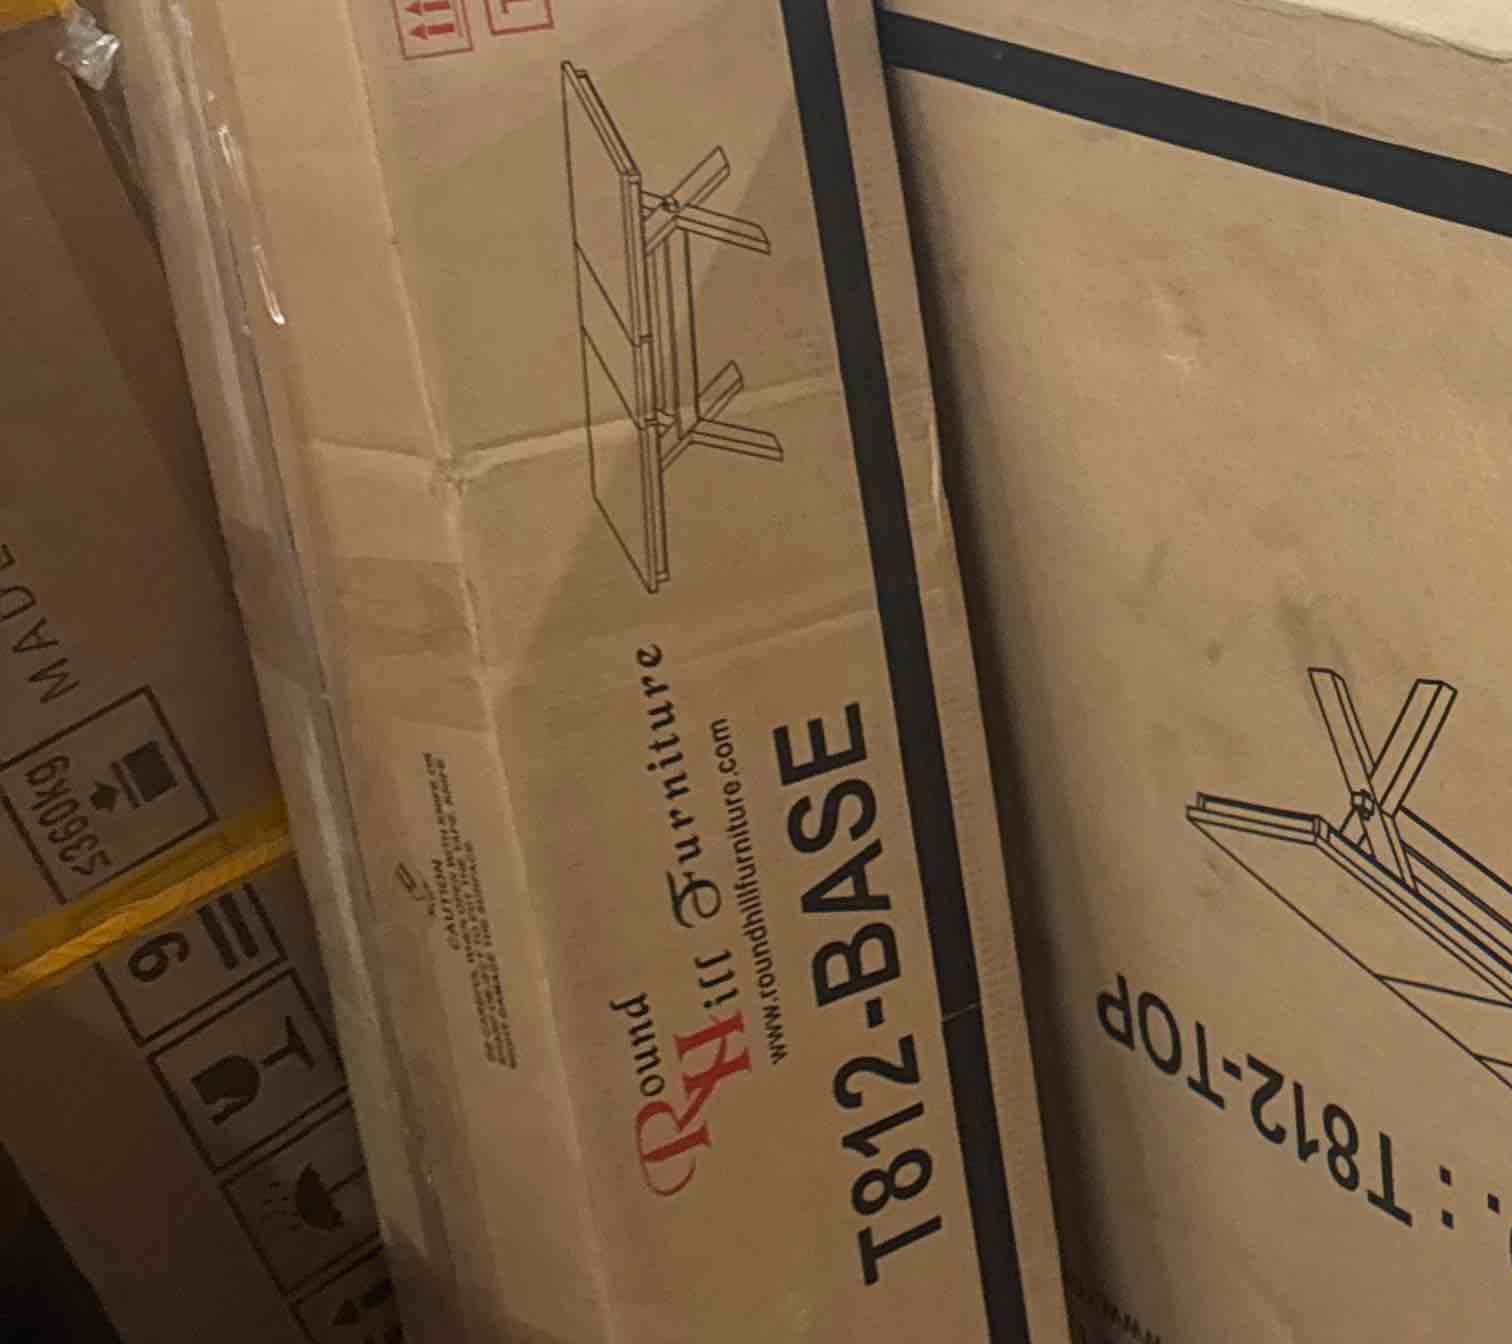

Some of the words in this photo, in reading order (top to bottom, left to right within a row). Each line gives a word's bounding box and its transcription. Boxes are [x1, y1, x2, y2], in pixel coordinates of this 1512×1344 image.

[635, 642, 722, 929] Furniture
[709, 717, 789, 1064] www.roundhillfurniture.com
[772, 701, 943, 1286] T812-BASE
[1096, 973, 1414, 1228] T812-TOP
